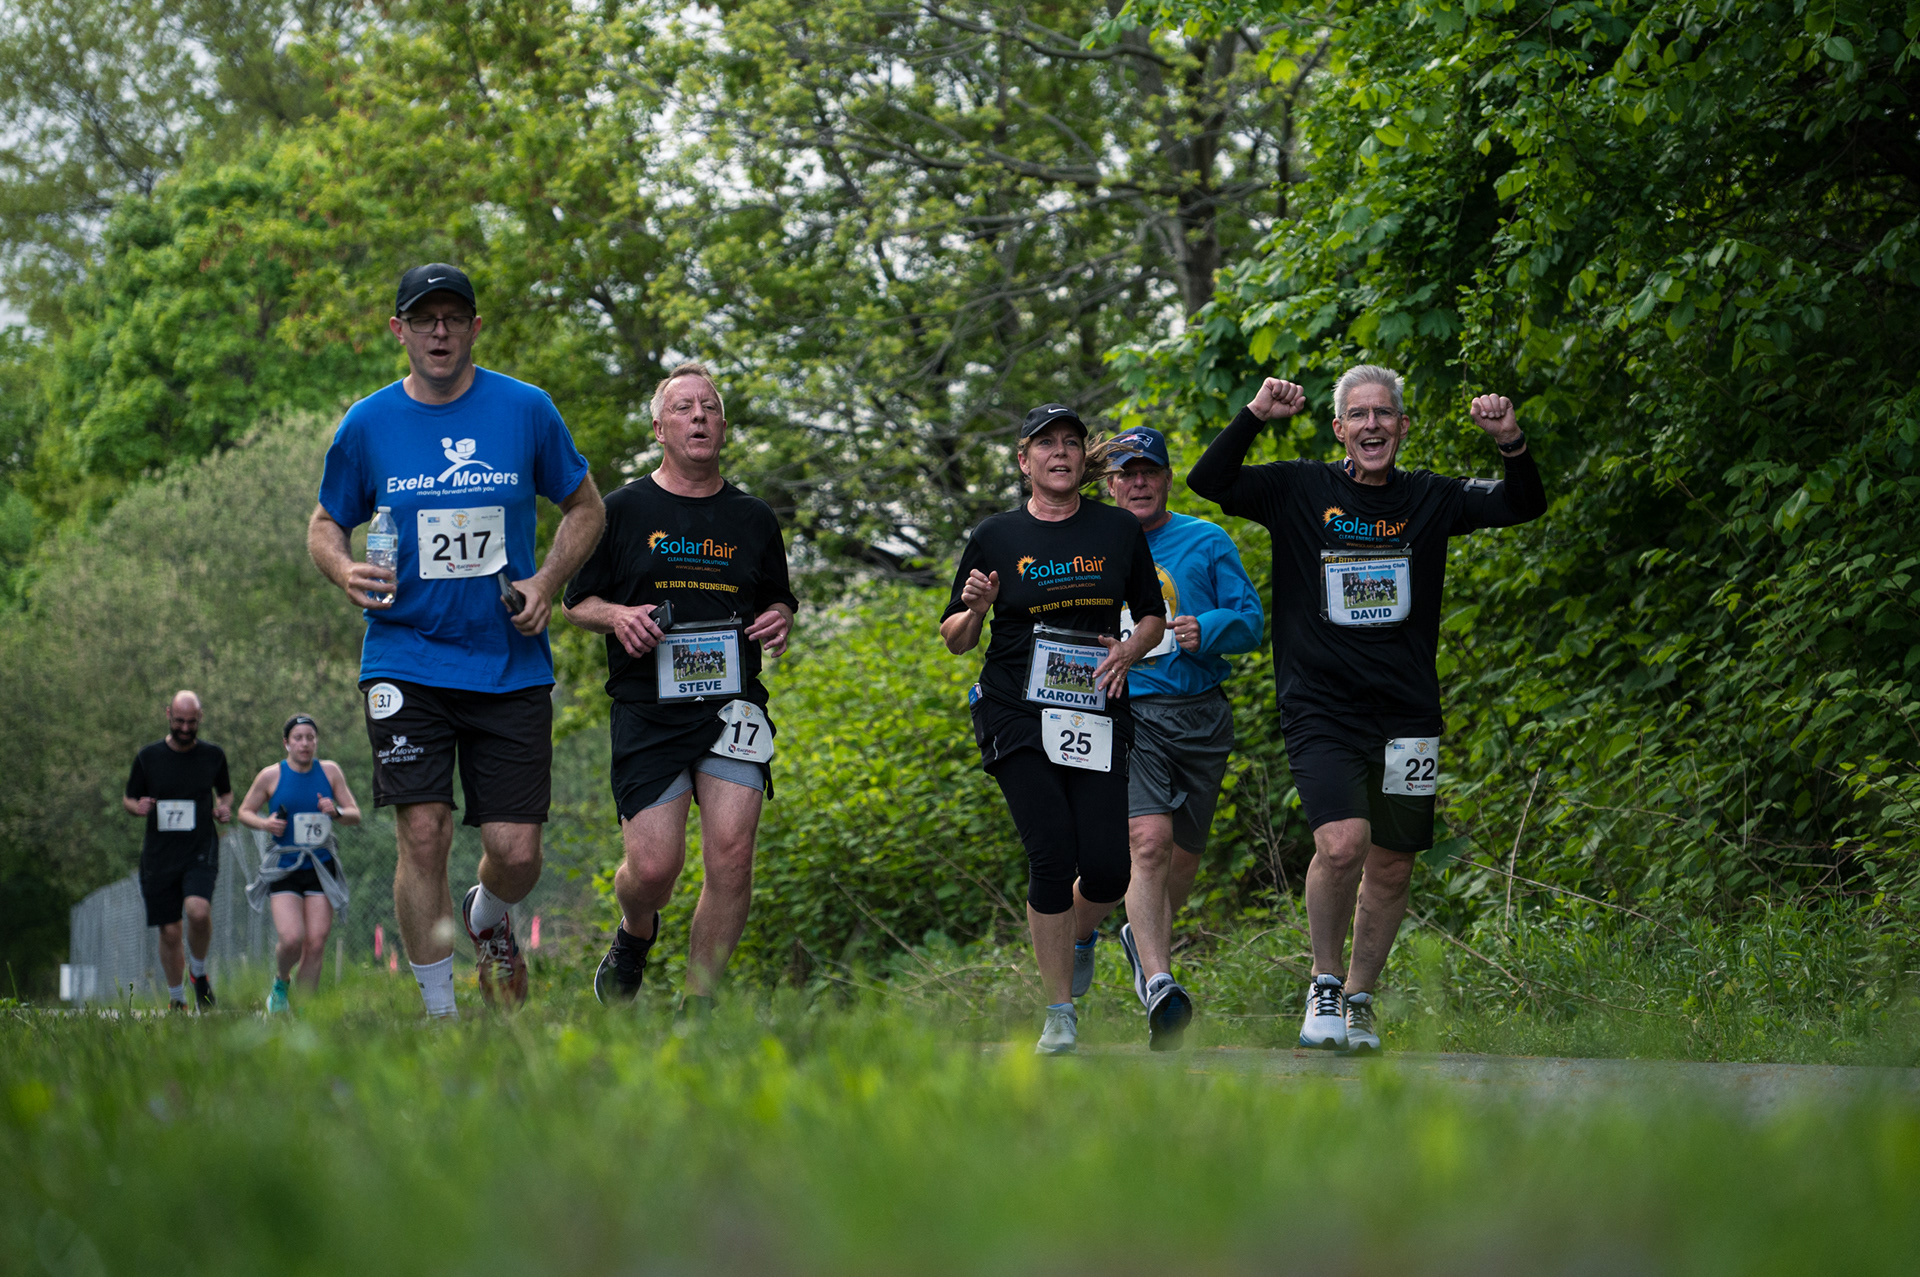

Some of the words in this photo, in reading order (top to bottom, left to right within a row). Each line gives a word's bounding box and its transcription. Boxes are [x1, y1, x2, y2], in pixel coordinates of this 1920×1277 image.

[386, 474, 435, 494] Exela
[452, 470, 519, 487] Movers
[416, 489, 441, 497] moving
[441, 487, 467, 496] forward
[432, 530, 491, 561] 217
[702, 558, 729, 567] SOLUTIONS
[655, 580, 668, 589] WE
[669, 580, 686, 588] RUN
[1038, 579, 1054, 587] CLEAN
[1054, 576, 1074, 584] ENERGY
[1028, 605, 1041, 614] WE
[1042, 602, 1060, 612] RUN
[1061, 600, 1073, 608] ON
[1351, 607, 1392, 620] DAVID
[1074, 649, 1095, 657] Running
[678, 680, 722, 693] STEVE
[378, 694, 391, 708] 3.1
[1036, 688, 1098, 706] KAROLYN
[731, 720, 760, 747] 17
[1059, 729, 1092, 755] 25
[396, 747, 424, 755] Movers
[1404, 758, 1435, 781] 22
[166, 810, 184, 823] 77
[304, 823, 322, 837] 76
